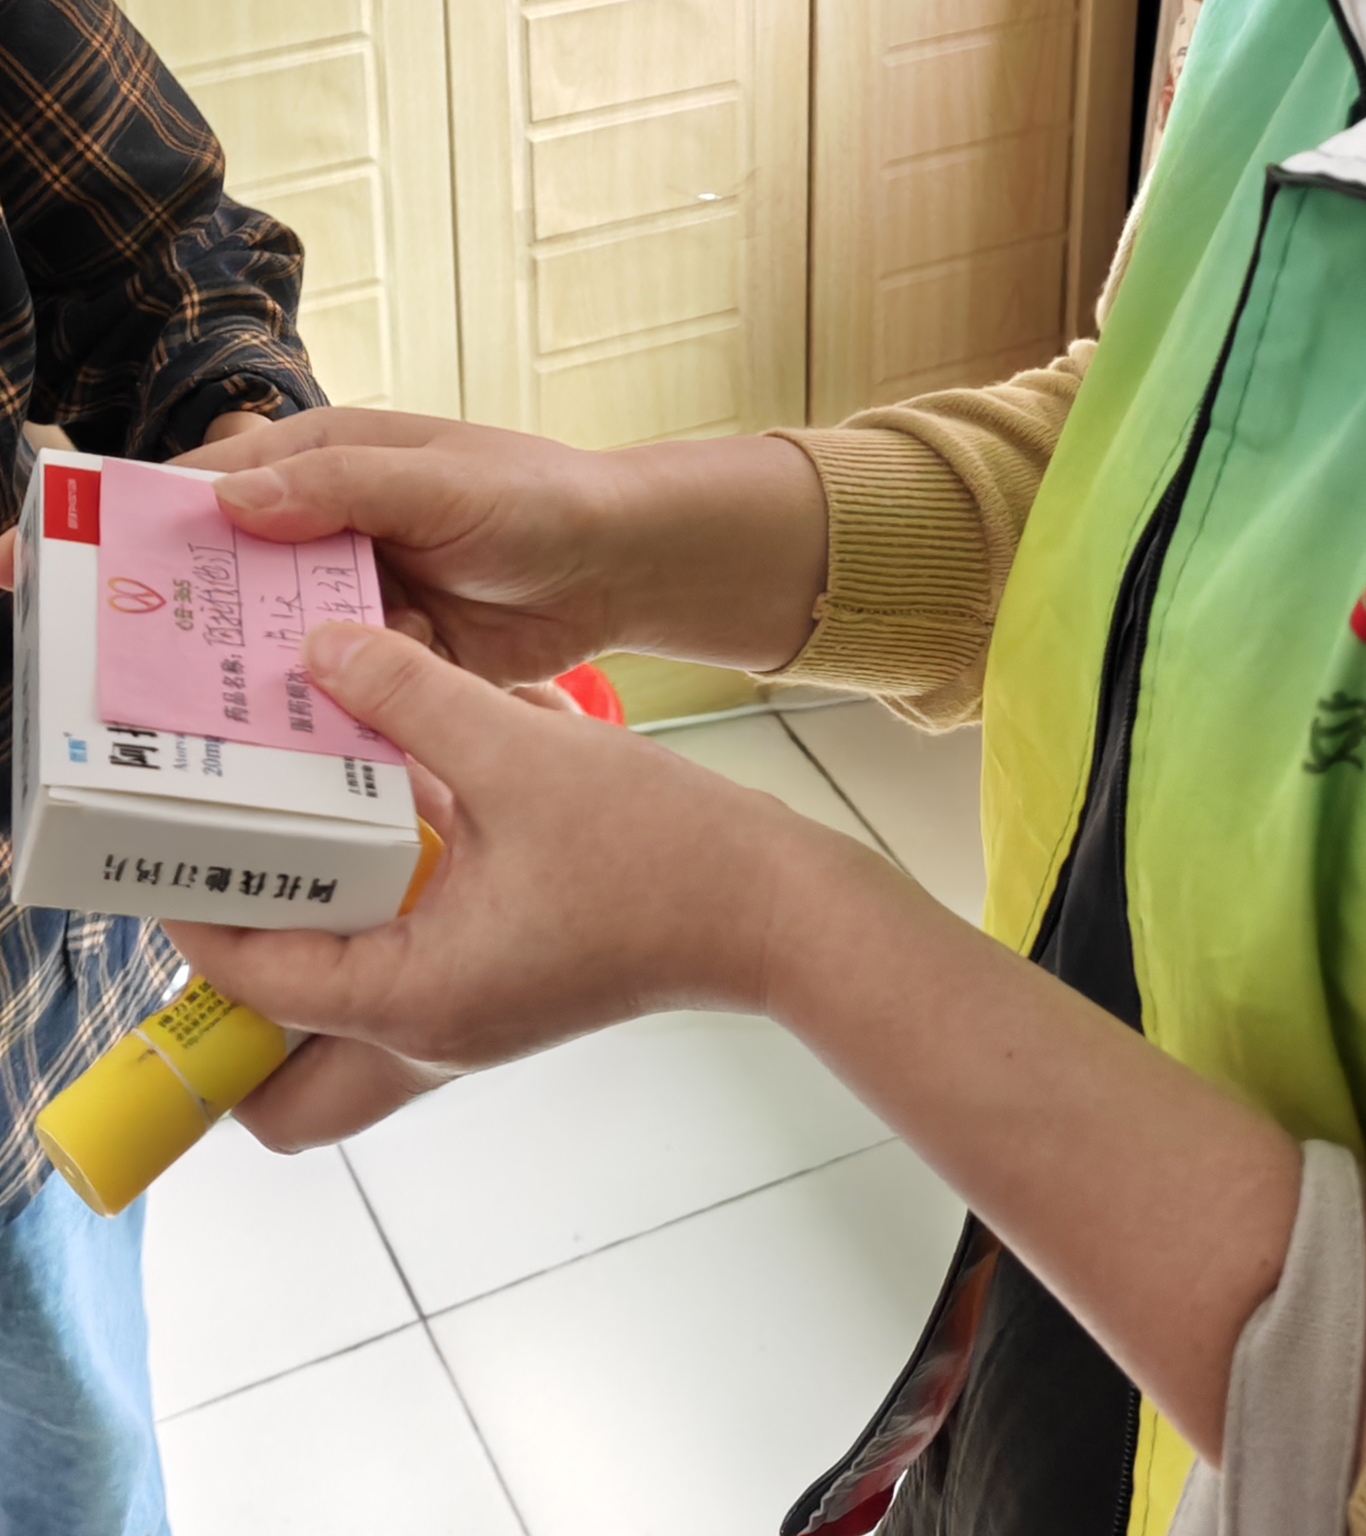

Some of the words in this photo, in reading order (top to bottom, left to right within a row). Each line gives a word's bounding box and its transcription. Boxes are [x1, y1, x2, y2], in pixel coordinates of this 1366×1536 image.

[102, 854, 338, 904] 阿托伐他汀钙片
